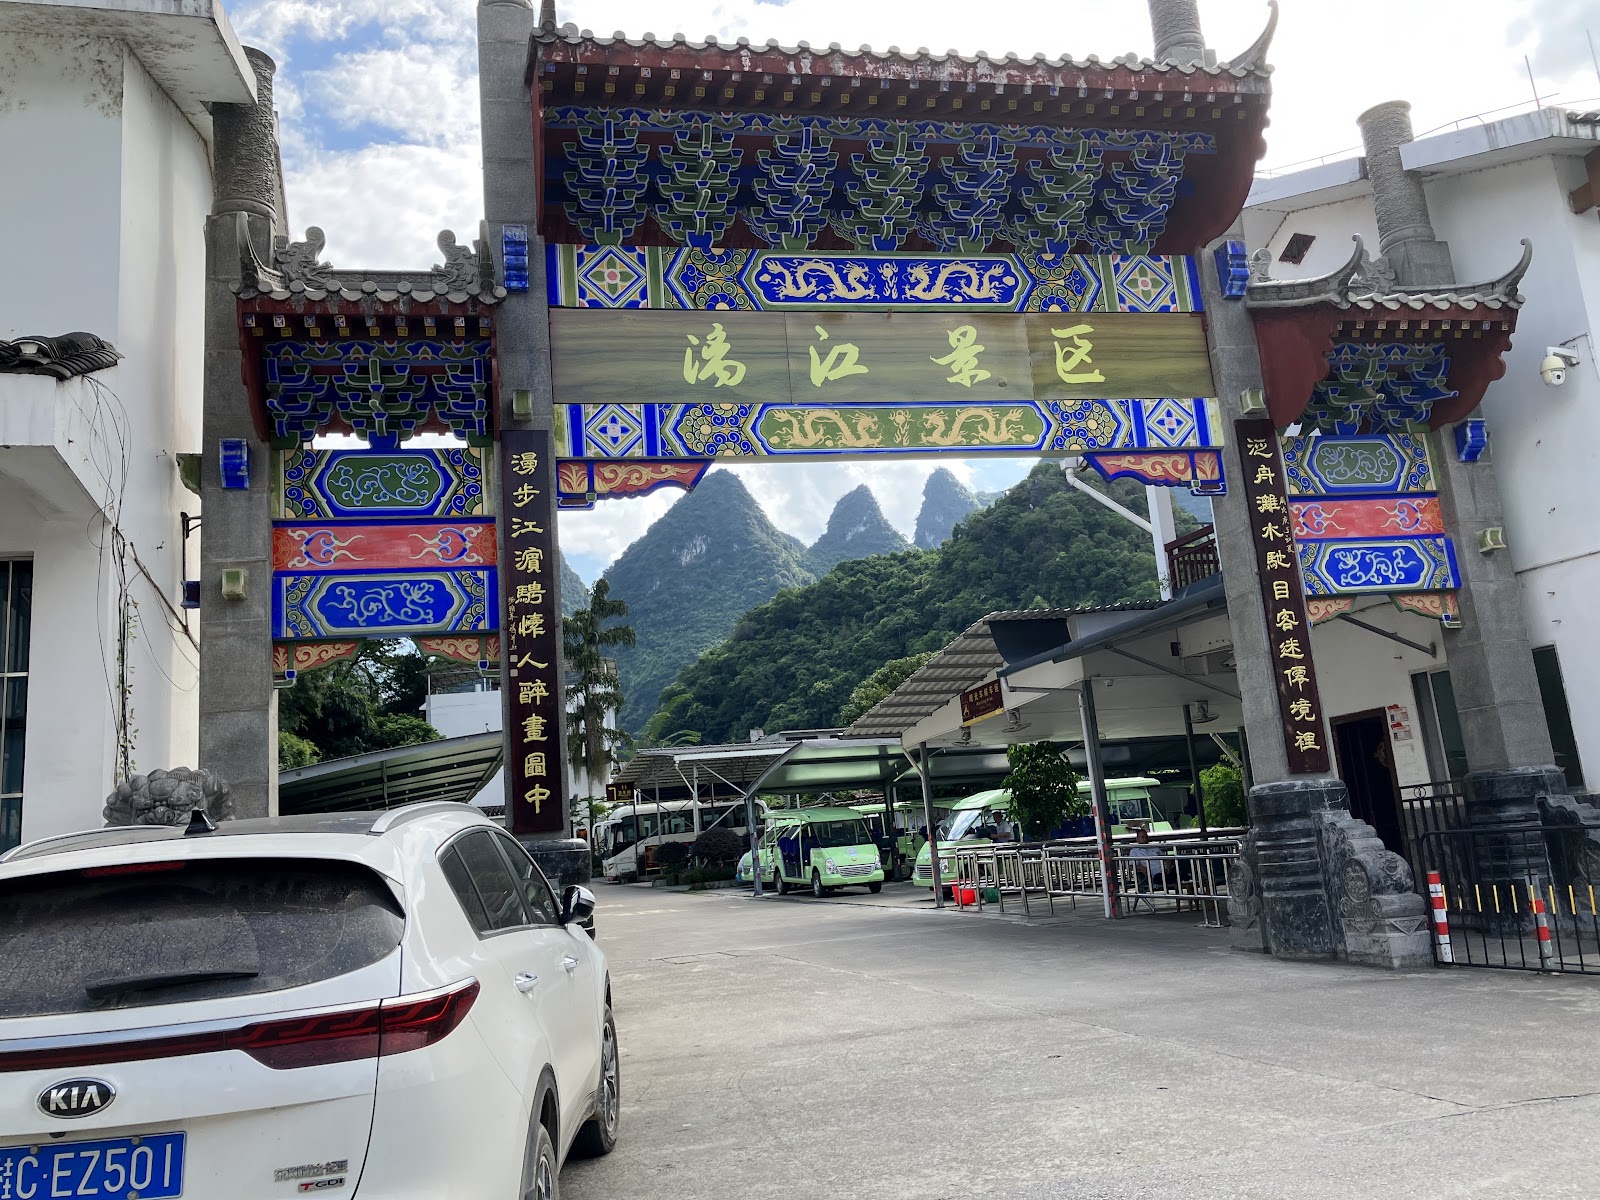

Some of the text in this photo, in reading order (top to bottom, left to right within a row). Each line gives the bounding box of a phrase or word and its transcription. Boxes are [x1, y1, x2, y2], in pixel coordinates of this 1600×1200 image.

[683, 322, 1105, 388] 漓江景区
[49, 1084, 103, 1112] KIA
